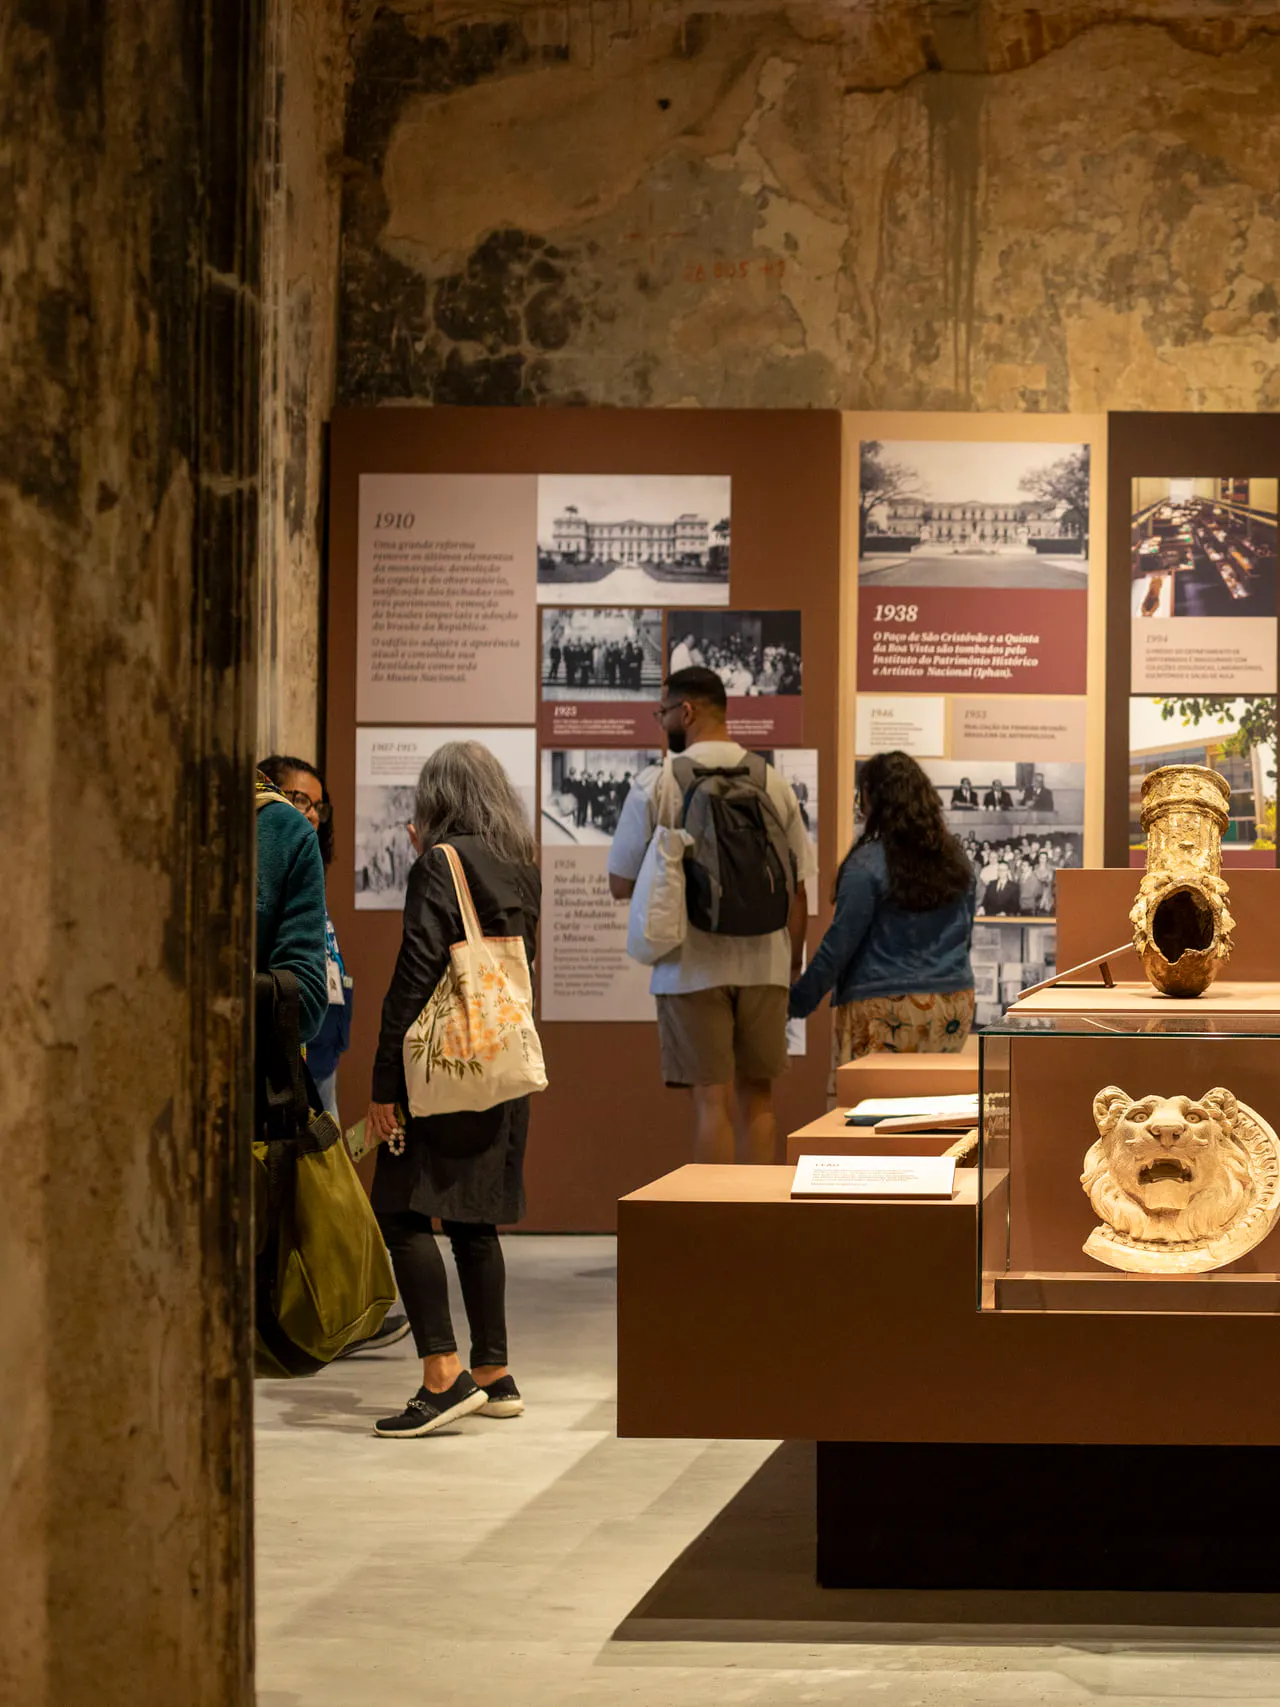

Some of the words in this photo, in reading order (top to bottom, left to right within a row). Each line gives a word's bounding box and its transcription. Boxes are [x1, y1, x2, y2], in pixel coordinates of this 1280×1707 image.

[374, 512, 416, 529] 1910
[874, 604, 918, 622] 1938
[874, 632, 882, 642] O
[884, 632, 906, 644] Paço
[908, 632, 920, 642] de
[922, 632, 939, 642] São
[940, 632, 988, 643] Cristóvão
[1005, 633, 1040, 646] Quinta
[874, 644, 886, 654] da
[888, 644, 907, 654] Boa
[909, 644, 934, 654] Vista
[936, 644, 954, 654] são
[955, 644, 1004, 655] tombados
[1005, 645, 1026, 657] pelo
[874, 655, 917, 665] Instituto
[918, 655, 932, 665] do
[933, 656, 990, 666] Patrimônio
[992, 656, 1038, 667] Histórico
[881, 666, 924, 676] Artístico
[926, 668, 972, 678] Nacional
